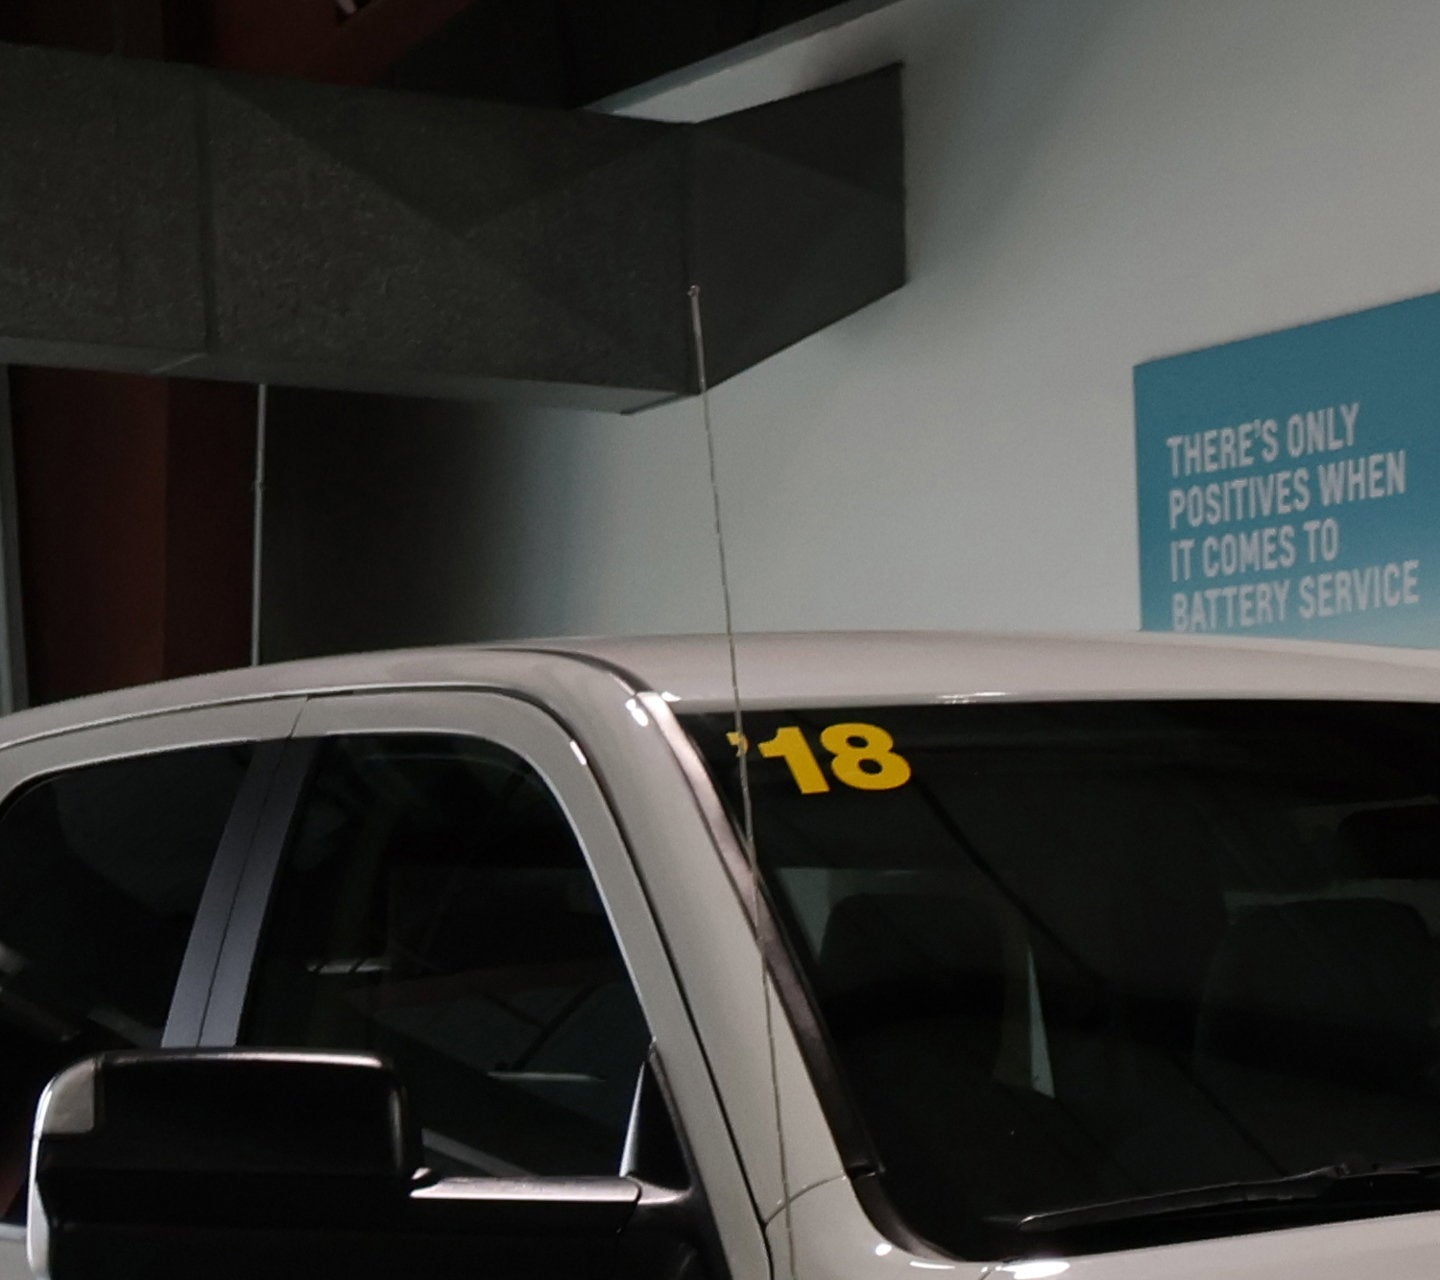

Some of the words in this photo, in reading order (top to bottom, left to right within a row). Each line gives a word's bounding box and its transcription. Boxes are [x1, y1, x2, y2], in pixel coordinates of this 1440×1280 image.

[1166, 418, 1279, 478] THERE'S
[1287, 403, 1359, 458] ONLY
[1169, 468, 1310, 530] POSITIVES
[1318, 450, 1406, 507] WHEN
[1170, 538, 1195, 582] IT
[1202, 526, 1295, 579] COMES
[1303, 518, 1339, 563] TO
[1172, 579, 1291, 632] BATTERY
[1299, 560, 1420, 619] SERVICE
